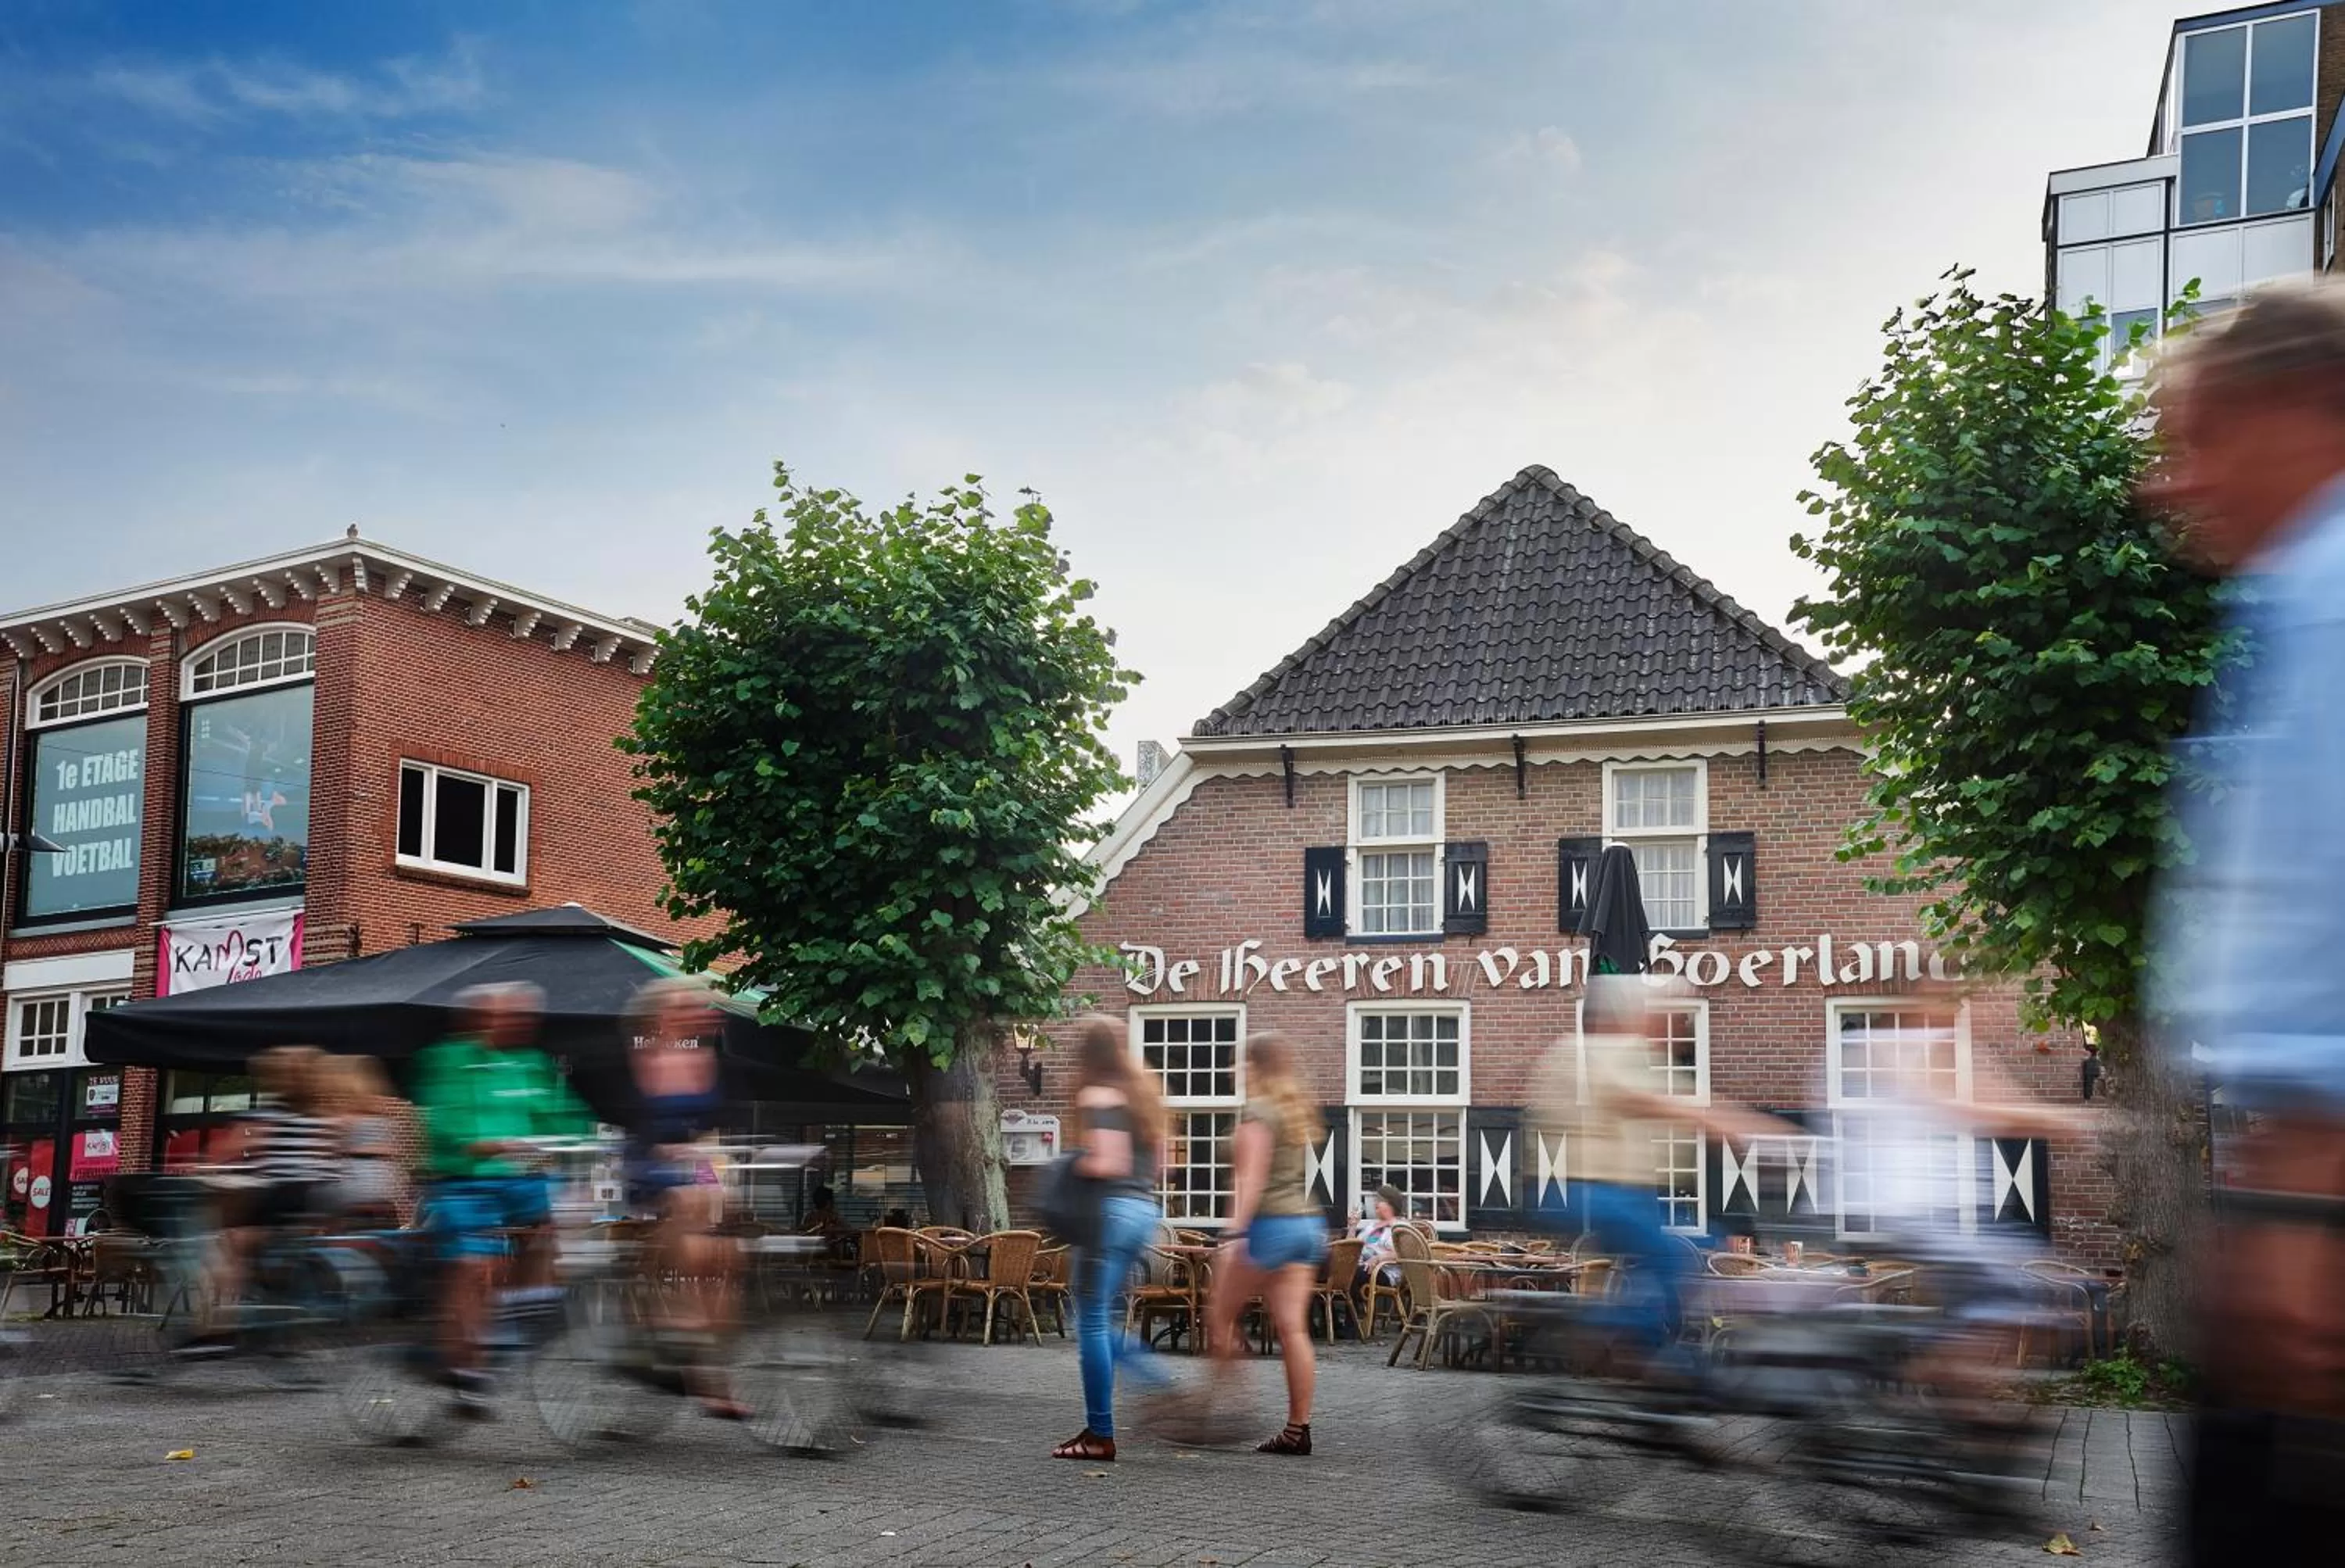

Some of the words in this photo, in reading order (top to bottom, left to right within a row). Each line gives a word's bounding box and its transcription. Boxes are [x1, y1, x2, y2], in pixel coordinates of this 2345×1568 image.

[56, 760, 77, 790] 1e
[81, 748, 139, 787] ETAGE
[52, 793, 137, 834] HANDBAL
[52, 837, 134, 877] VOETBAL
[1119, 940, 1200, 995] De
[1220, 940, 1449, 995] Heeren
[1477, 947, 1591, 989] van
[32, 1187, 50, 1197] SALE
